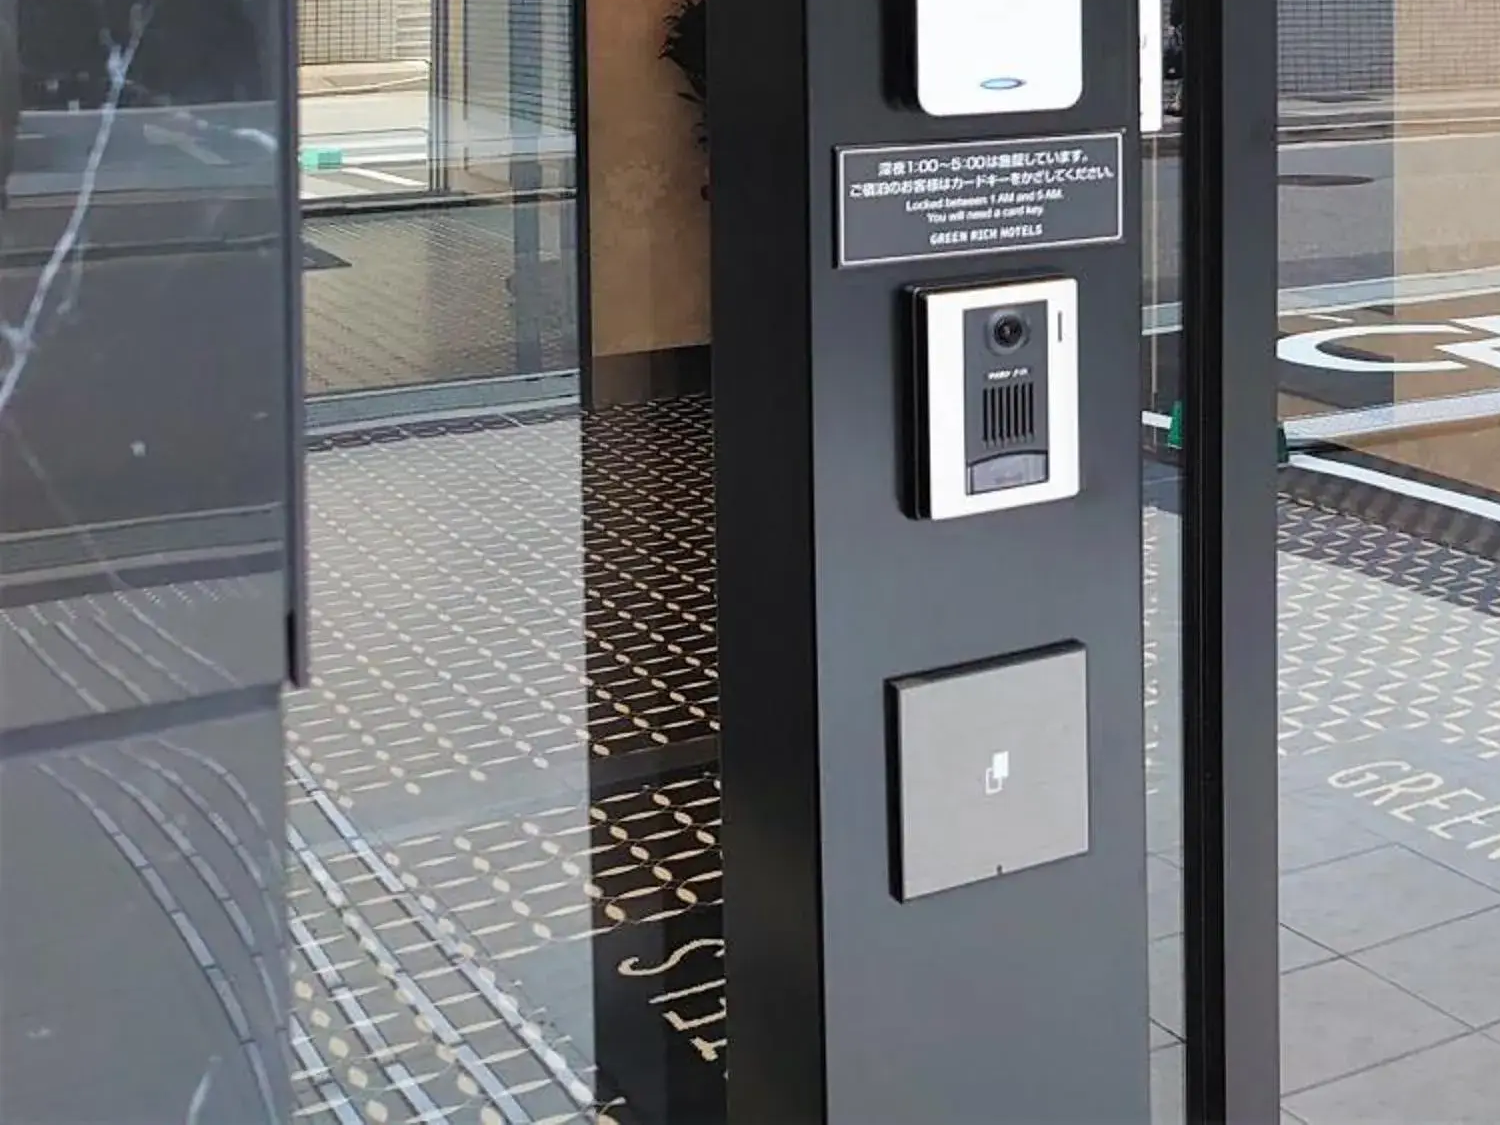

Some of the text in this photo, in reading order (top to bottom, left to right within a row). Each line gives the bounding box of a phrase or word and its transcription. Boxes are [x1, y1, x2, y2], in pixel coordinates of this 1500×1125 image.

[905, 198, 943, 212] Locked
[945, 195, 988, 209] between
[997, 191, 1015, 204] AM
[1016, 190, 1035, 203] and
[926, 212, 947, 223] You
[948, 210, 965, 221] will
[966, 207, 992, 220] need
[1002, 206, 1025, 217] card
[929, 224, 1043, 245] GREEN RICH HOTELS
